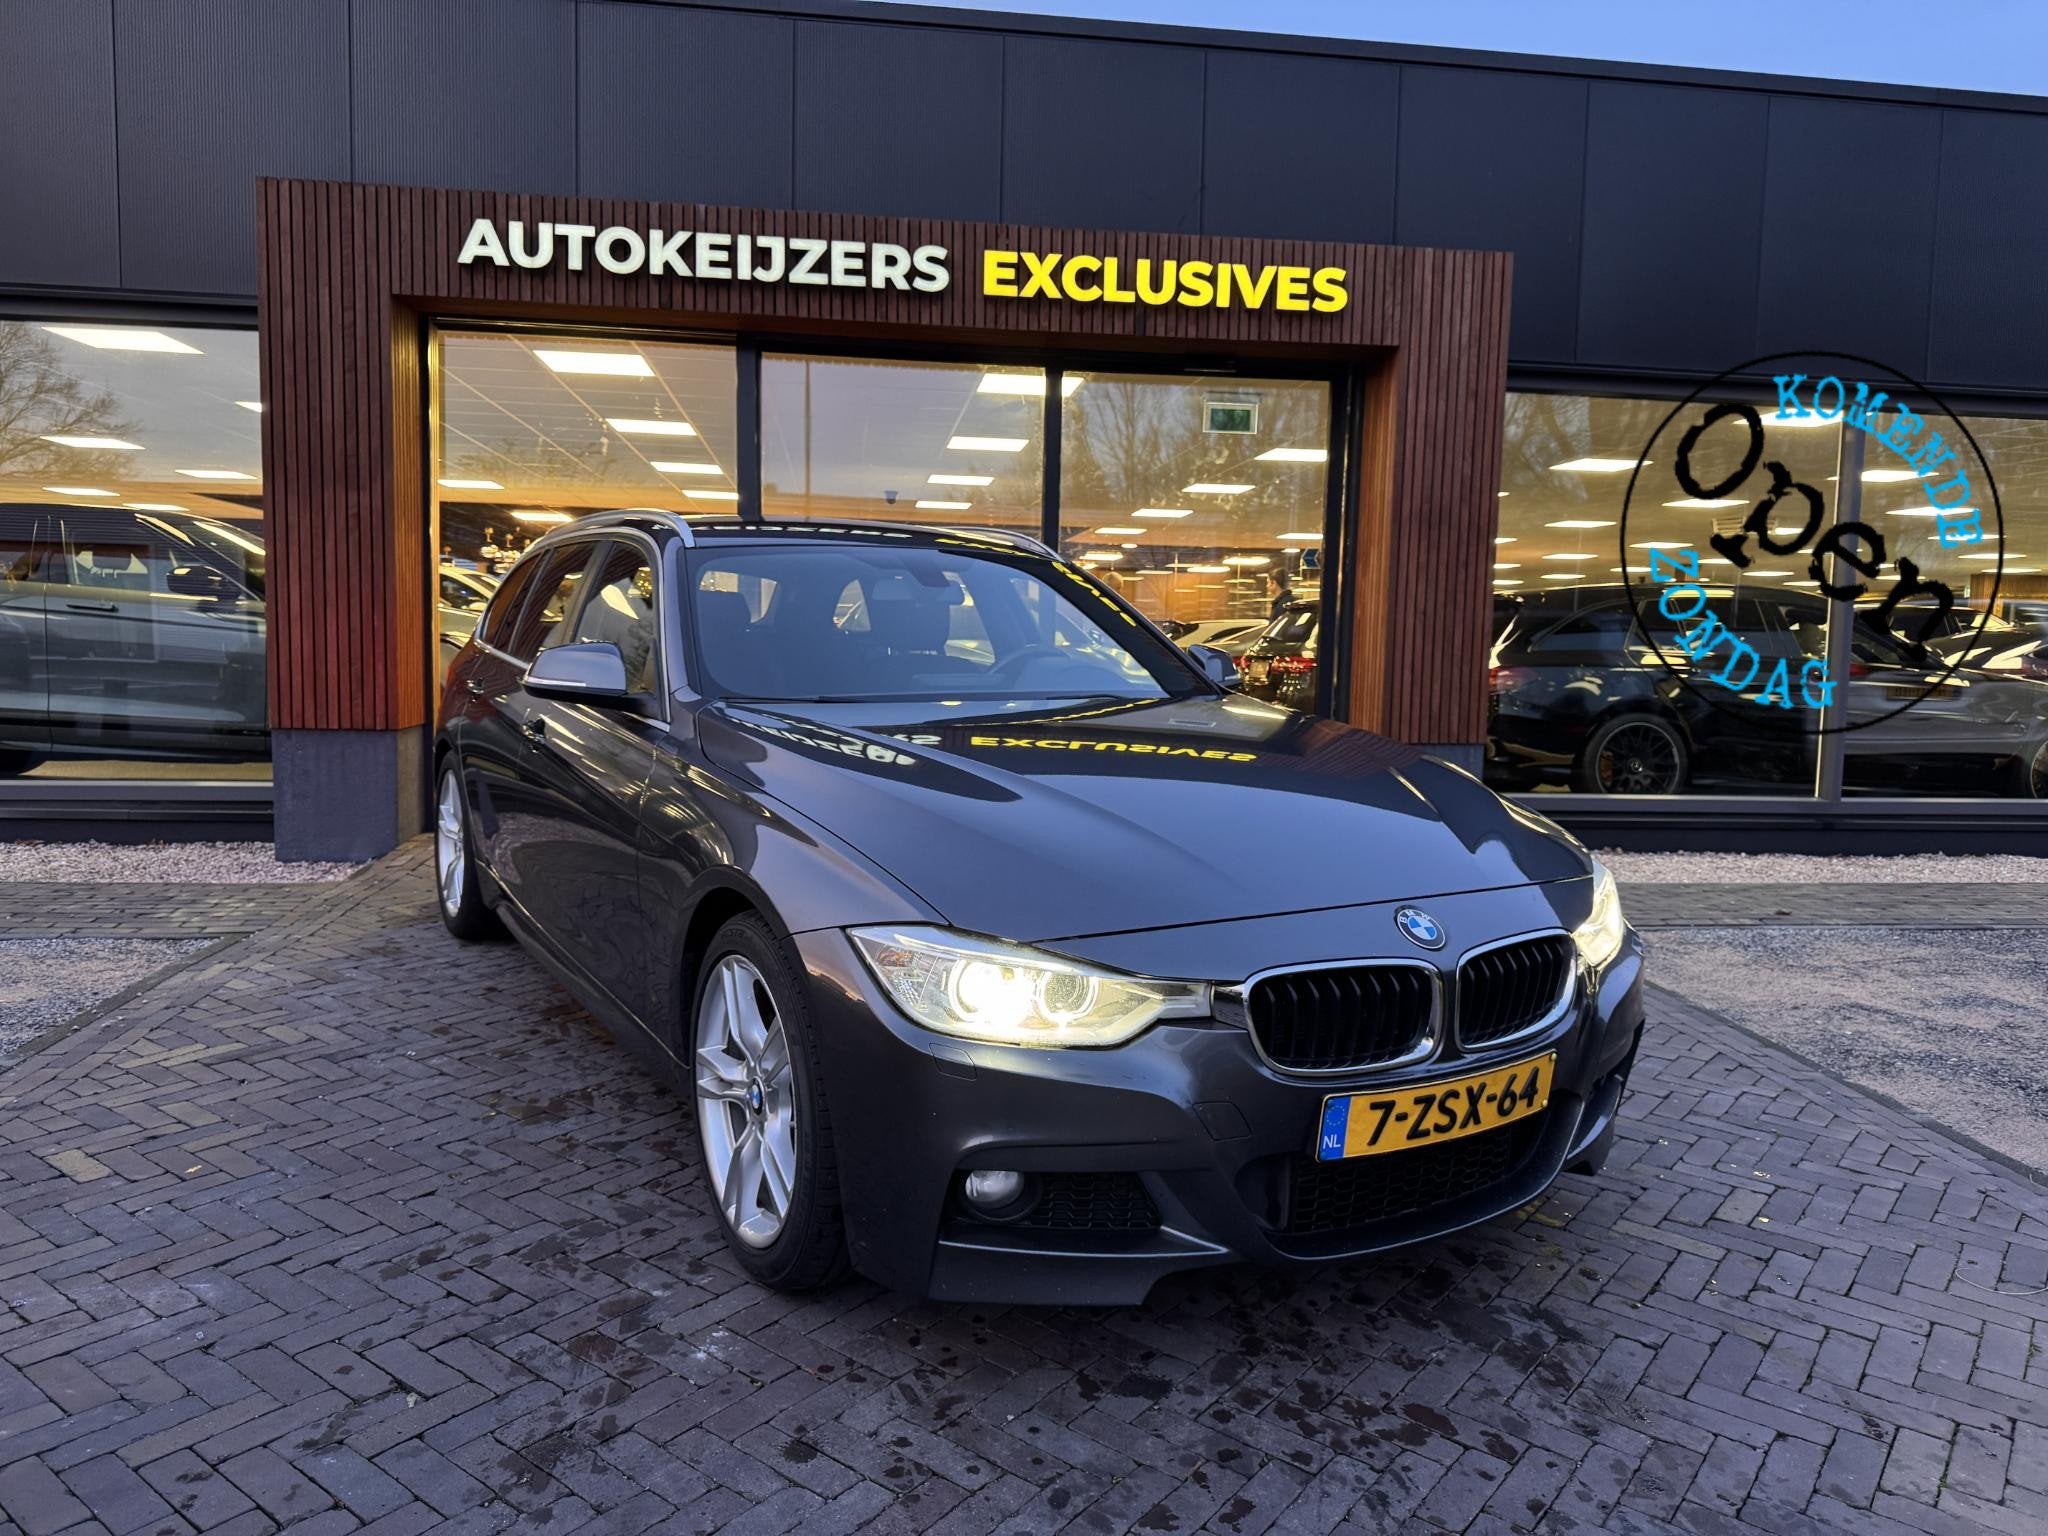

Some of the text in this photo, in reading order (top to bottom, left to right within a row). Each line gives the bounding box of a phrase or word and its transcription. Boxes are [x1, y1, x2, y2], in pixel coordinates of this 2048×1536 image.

[457, 218, 1349, 313] AUTOKEIJZERS EXCLUSIVES
[1323, 1134, 1341, 1150] NL
[1367, 1066, 1540, 1146] 7-ZSX-64
